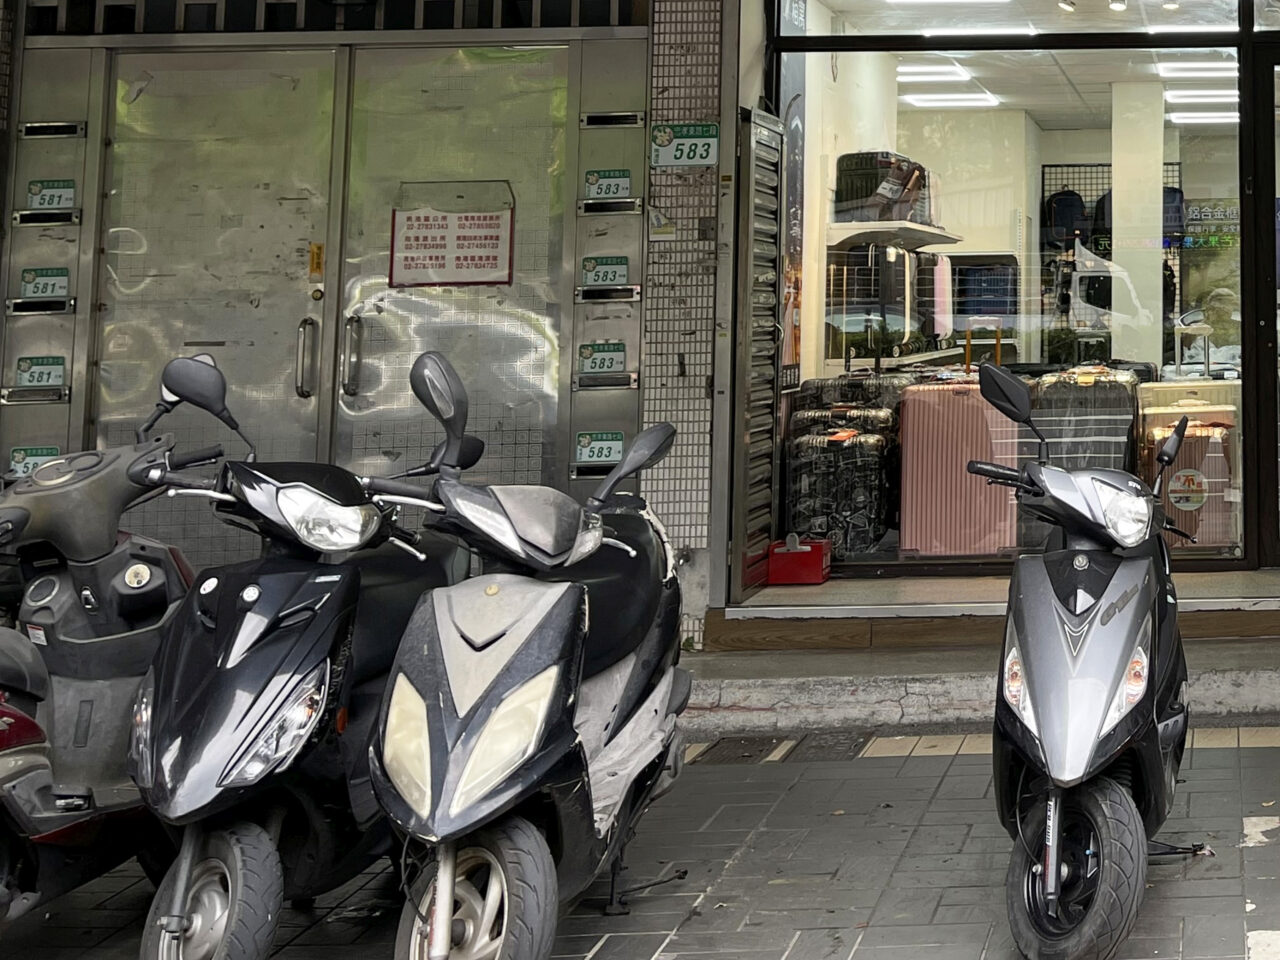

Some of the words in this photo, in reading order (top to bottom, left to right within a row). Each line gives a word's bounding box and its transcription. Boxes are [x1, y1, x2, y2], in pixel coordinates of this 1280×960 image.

[674, 143, 711, 160] 583
[597, 183, 619, 195] 583
[39, 194, 62, 206] 581
[594, 270, 617, 282] 583
[32, 282, 56, 294] 581
[590, 357, 614, 369] 583
[28, 371, 51, 383] 581
[588, 446, 612, 458] 583
